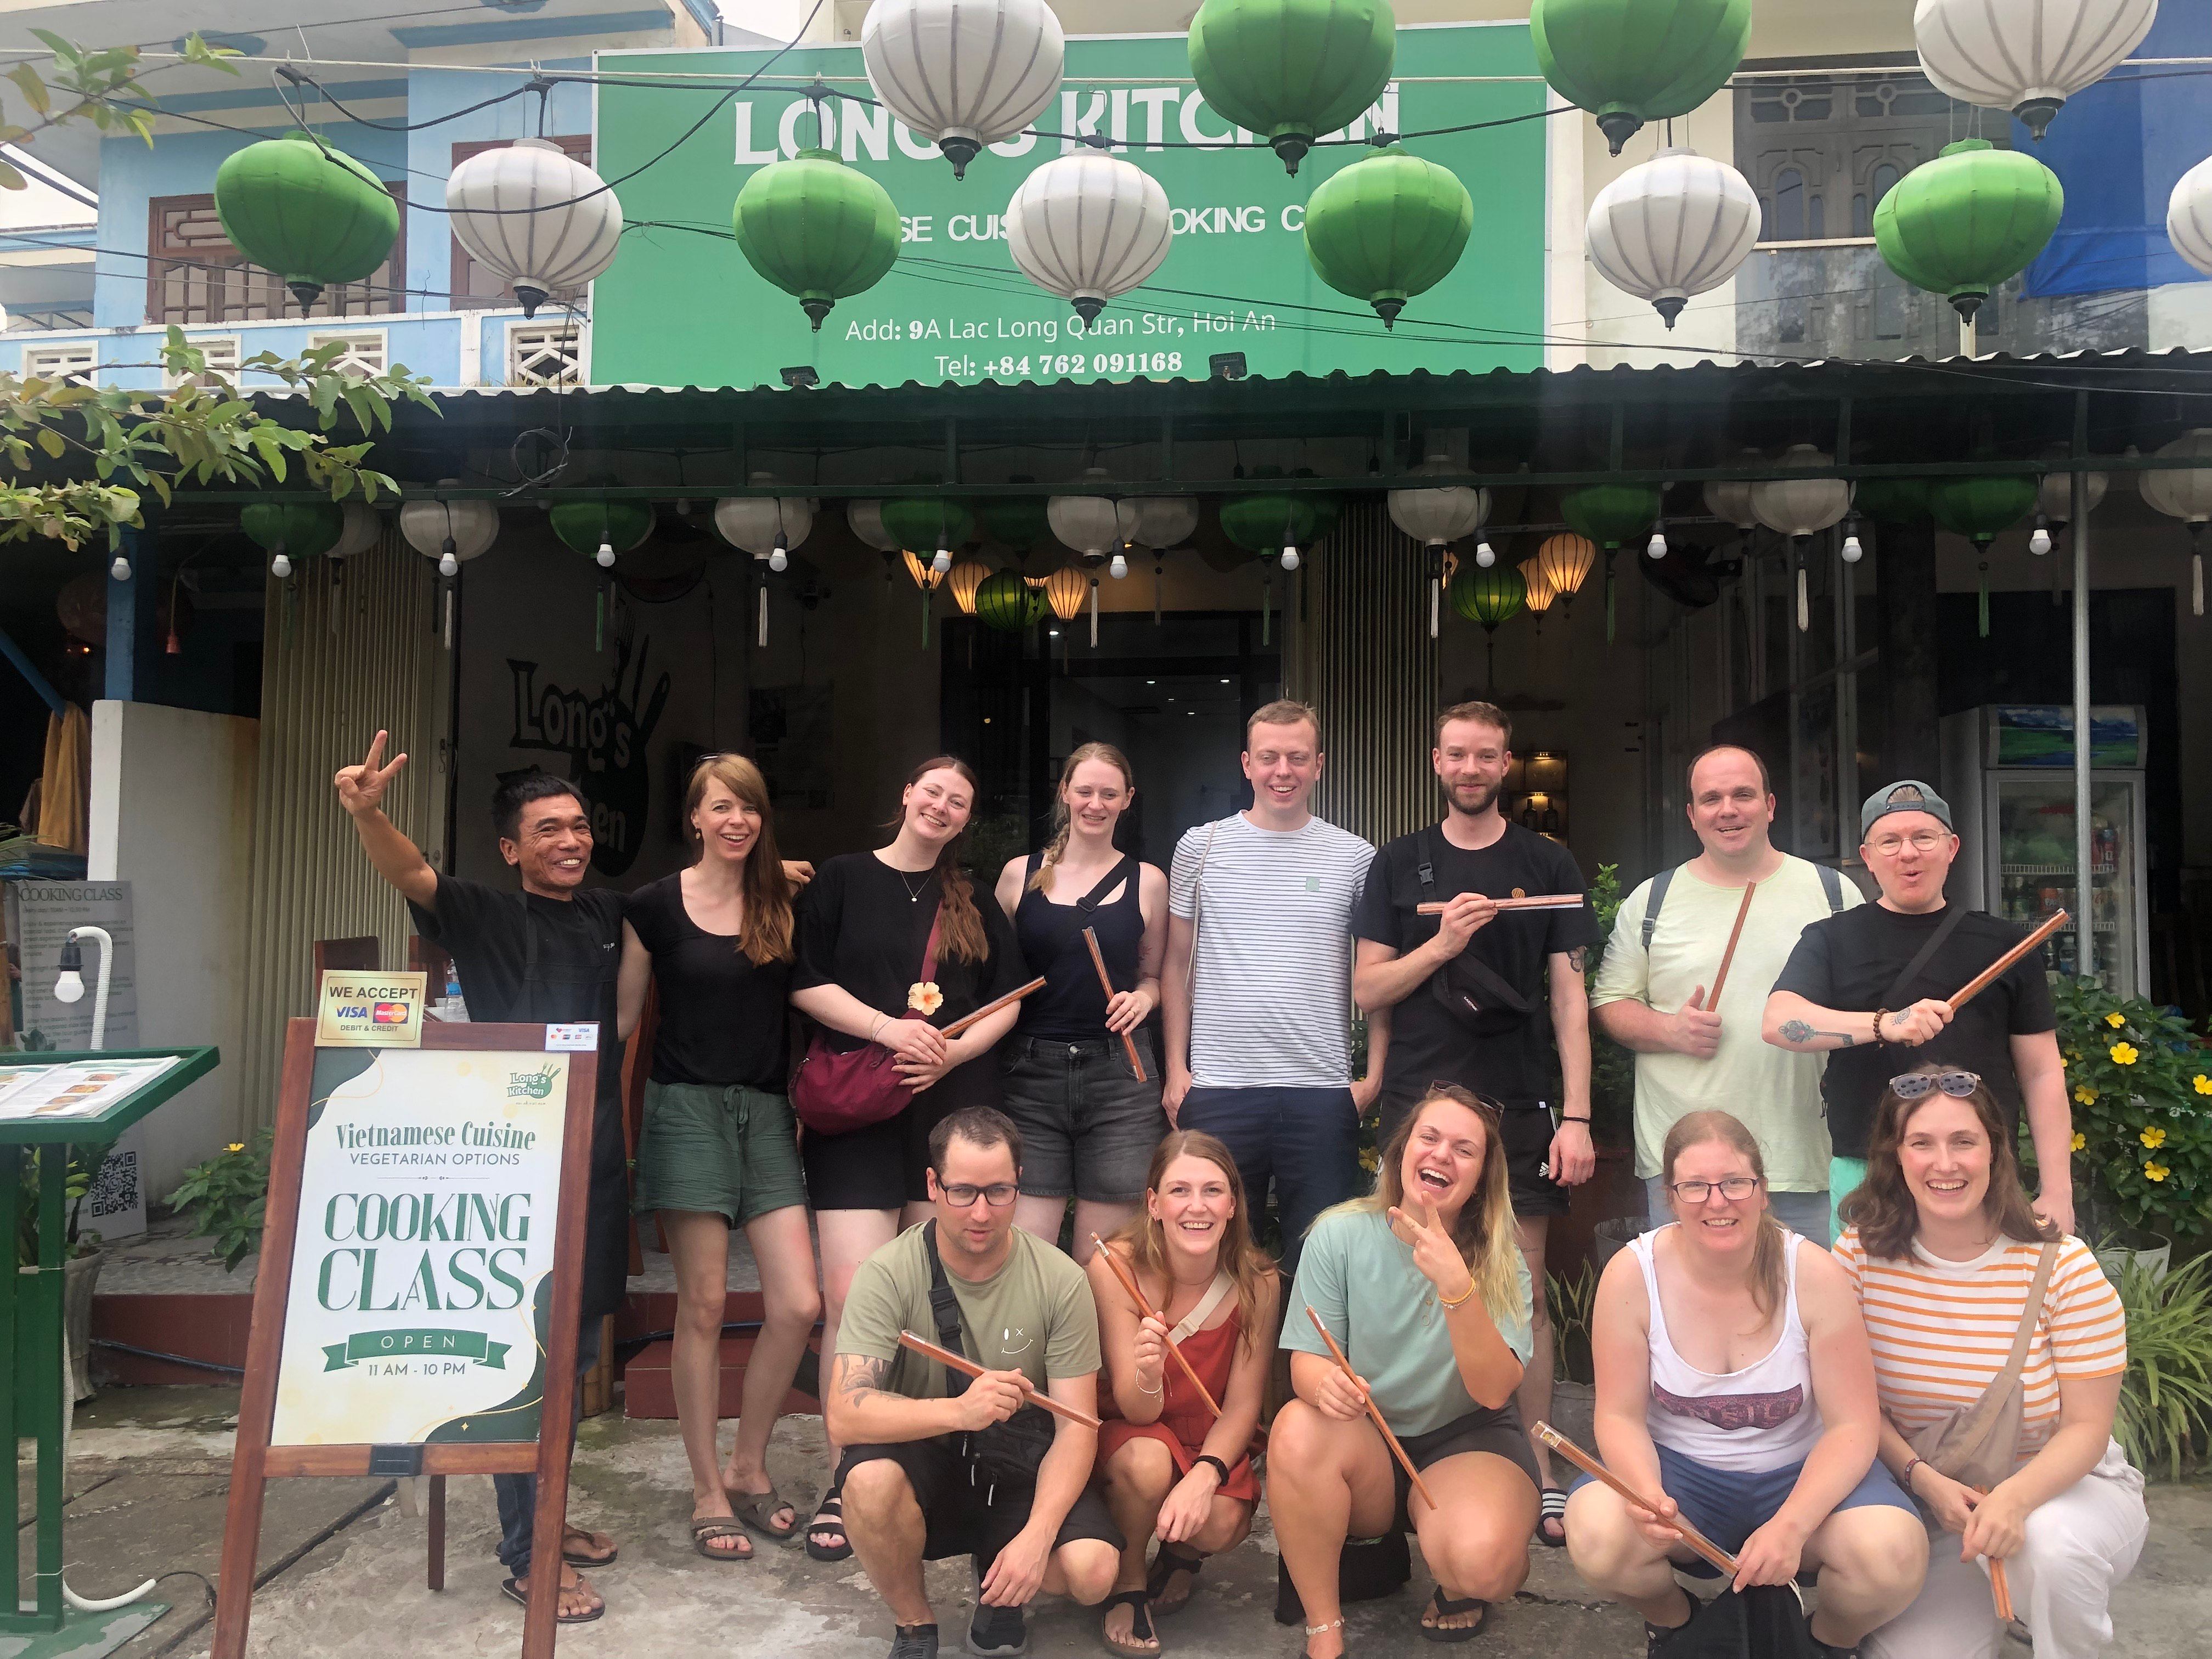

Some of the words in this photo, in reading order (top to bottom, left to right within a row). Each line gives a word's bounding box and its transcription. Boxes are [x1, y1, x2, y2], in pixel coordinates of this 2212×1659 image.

[1060, 82, 1400, 155] KITCN
[845, 318, 901, 341] Add:
[909, 318, 941, 340] 9A
[950, 318, 989, 338] Lac
[998, 317, 1057, 343] Long
[1066, 314, 1133, 340] Quan
[1142, 313, 1184, 337] Str,
[1194, 311, 1234, 332] Hoi
[1243, 310, 1276, 331] An
[934, 354, 975, 376] Tel:
[983, 356, 1030, 375] +84
[1039, 354, 1085, 374] 762
[1093, 352, 1182, 373] 091168
[21, 888, 81, 901] COOKING
[84, 888, 123, 901] CLASS
[330, 986, 353, 997] WE
[357, 987, 418, 998] ACCEPT
[336, 1007, 368, 1018] VISA
[507, 1086, 545, 1097] Kitchen
[336, 1122, 455, 1150] Vietnamese
[461, 1121, 536, 1150] Cuisine
[350, 1153, 446, 1166] VEGETARIAN
[452, 1153, 521, 1166] OPTIONS
[324, 1193, 531, 1242] COOKING
[317, 1248, 526, 1311] CLASS
[381, 1335, 456, 1348] OPEN
[369, 1364, 378, 1376] 11
[383, 1363, 408, 1376] AM
[424, 1364, 438, 1375] 10
[443, 1363, 465, 1375] PM
